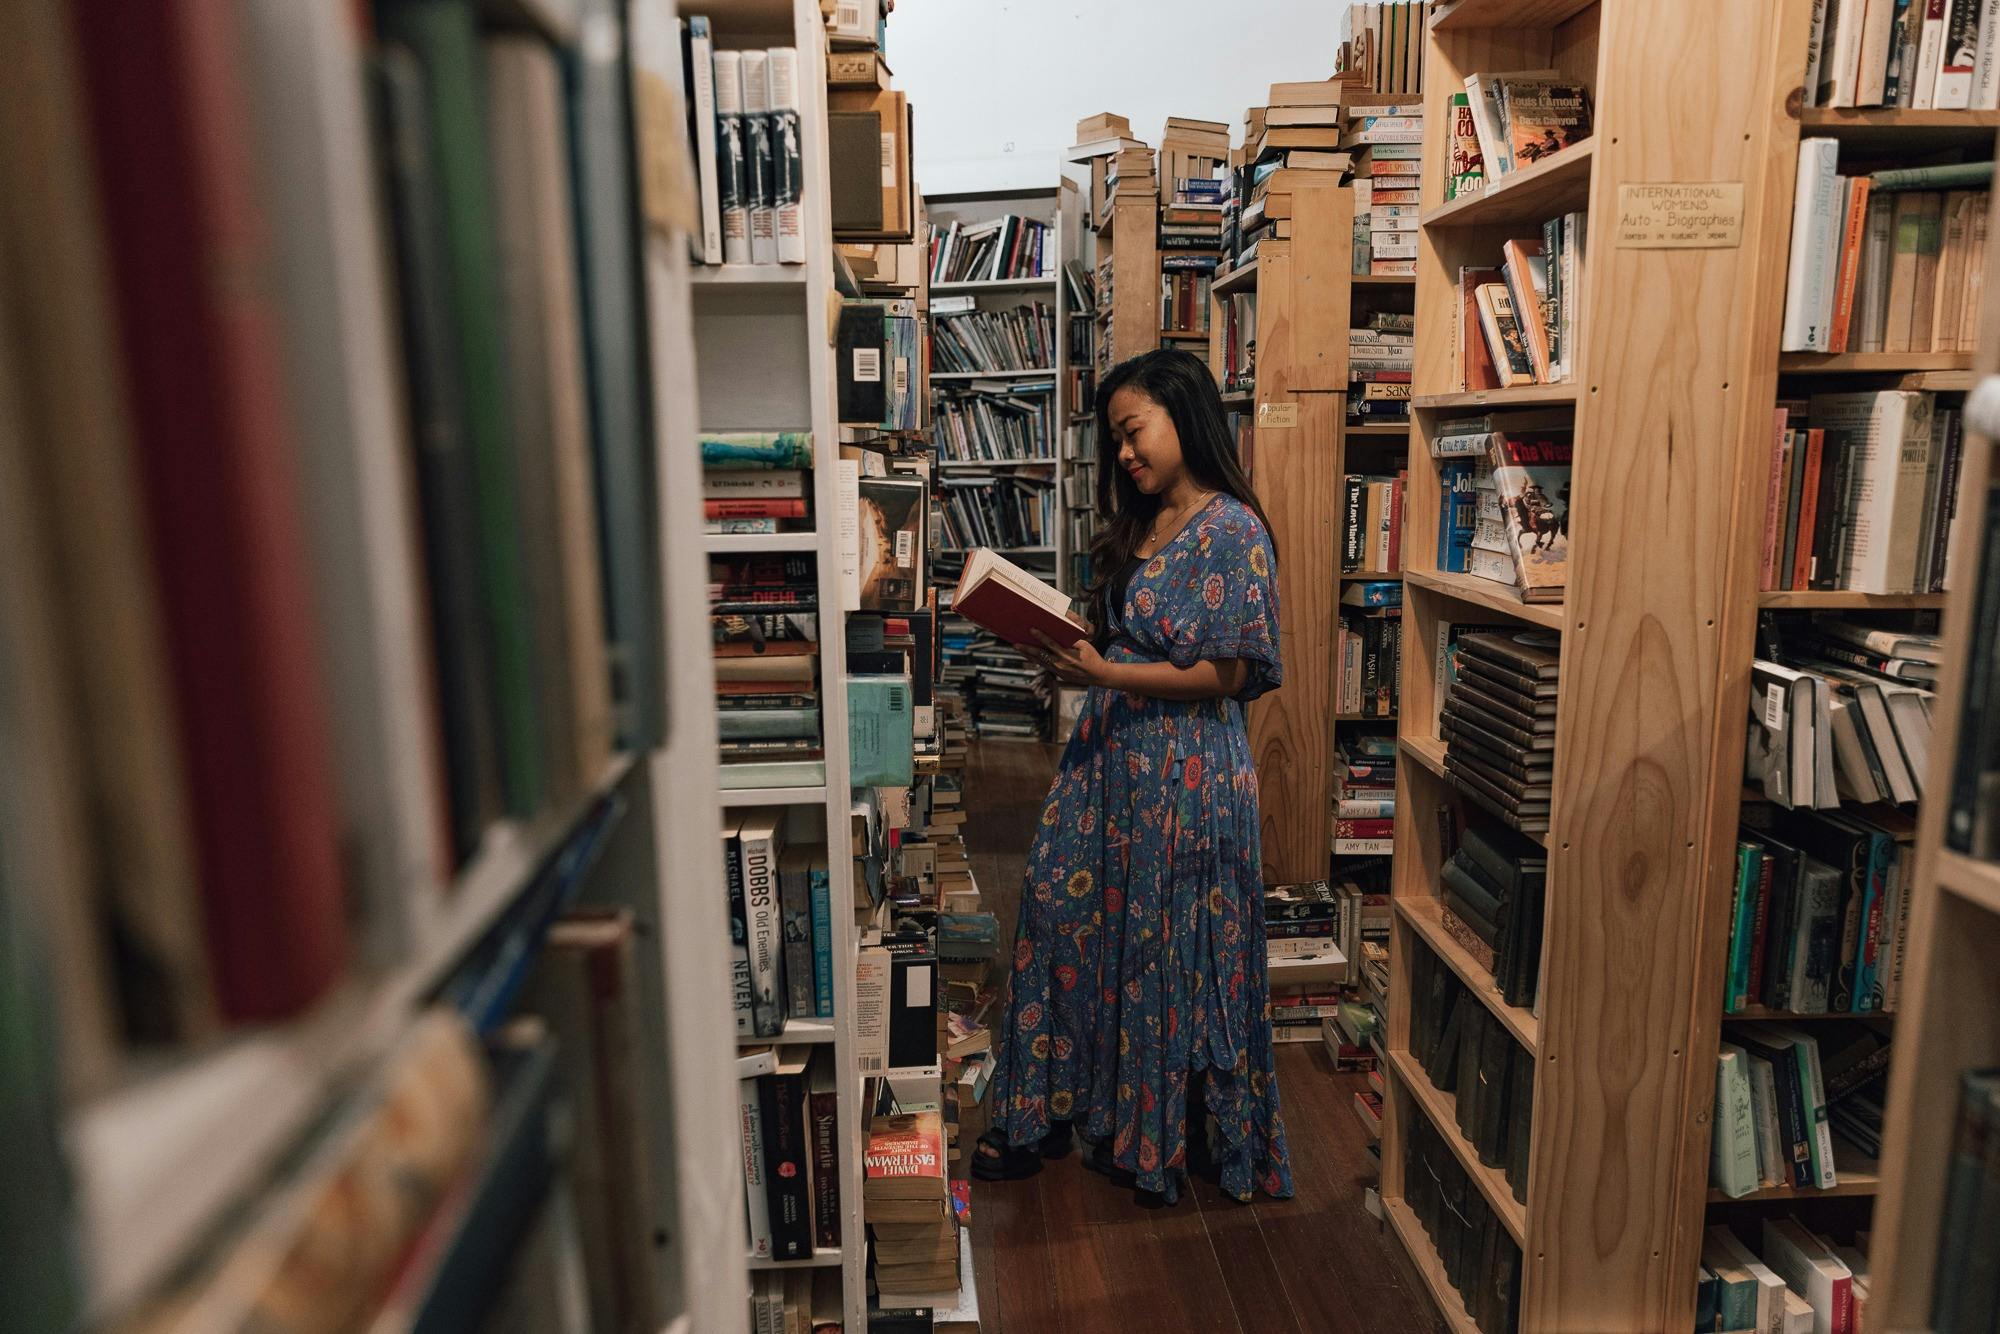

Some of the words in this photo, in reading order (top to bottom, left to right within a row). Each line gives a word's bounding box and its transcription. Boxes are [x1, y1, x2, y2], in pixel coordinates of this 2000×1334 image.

[1627, 187, 1724, 199] INTERNATIONAL
[1652, 199, 1709, 211] WOMENS
[753, 212, 773, 240] HOPE
[779, 209, 798, 238] HOPE
[1621, 213, 1651, 227] Auto
[1666, 211, 1735, 229] Biographies
[1266, 404, 1291, 413] opular
[1350, 486, 1360, 503] The
[1349, 503, 1359, 524] Love
[1347, 524, 1358, 560] Machine
[1368, 653, 1377, 680] PASHA
[1345, 807, 1362, 817] AMY
[1363, 807, 1378, 816] TAN
[1344, 842, 1361, 851] AMY
[1364, 842, 1379, 850] TAN
[726, 850, 739, 901] MICHAEL
[747, 855, 770, 907] DOBBS
[755, 911, 769, 928] Old
[756, 930, 771, 973] Enemies
[732, 959, 751, 1011] NEVER
[740, 1104, 751, 1145] GABRIELLE
[749, 1115, 760, 1134] done
[751, 1135, 763, 1154] with
[816, 1114, 834, 1169] Slammerkin
[744, 1145, 755, 1187] DONNELLY
[864, 1154, 935, 1168] EASTERMAN
[883, 1164, 918, 1176] DANIEL
